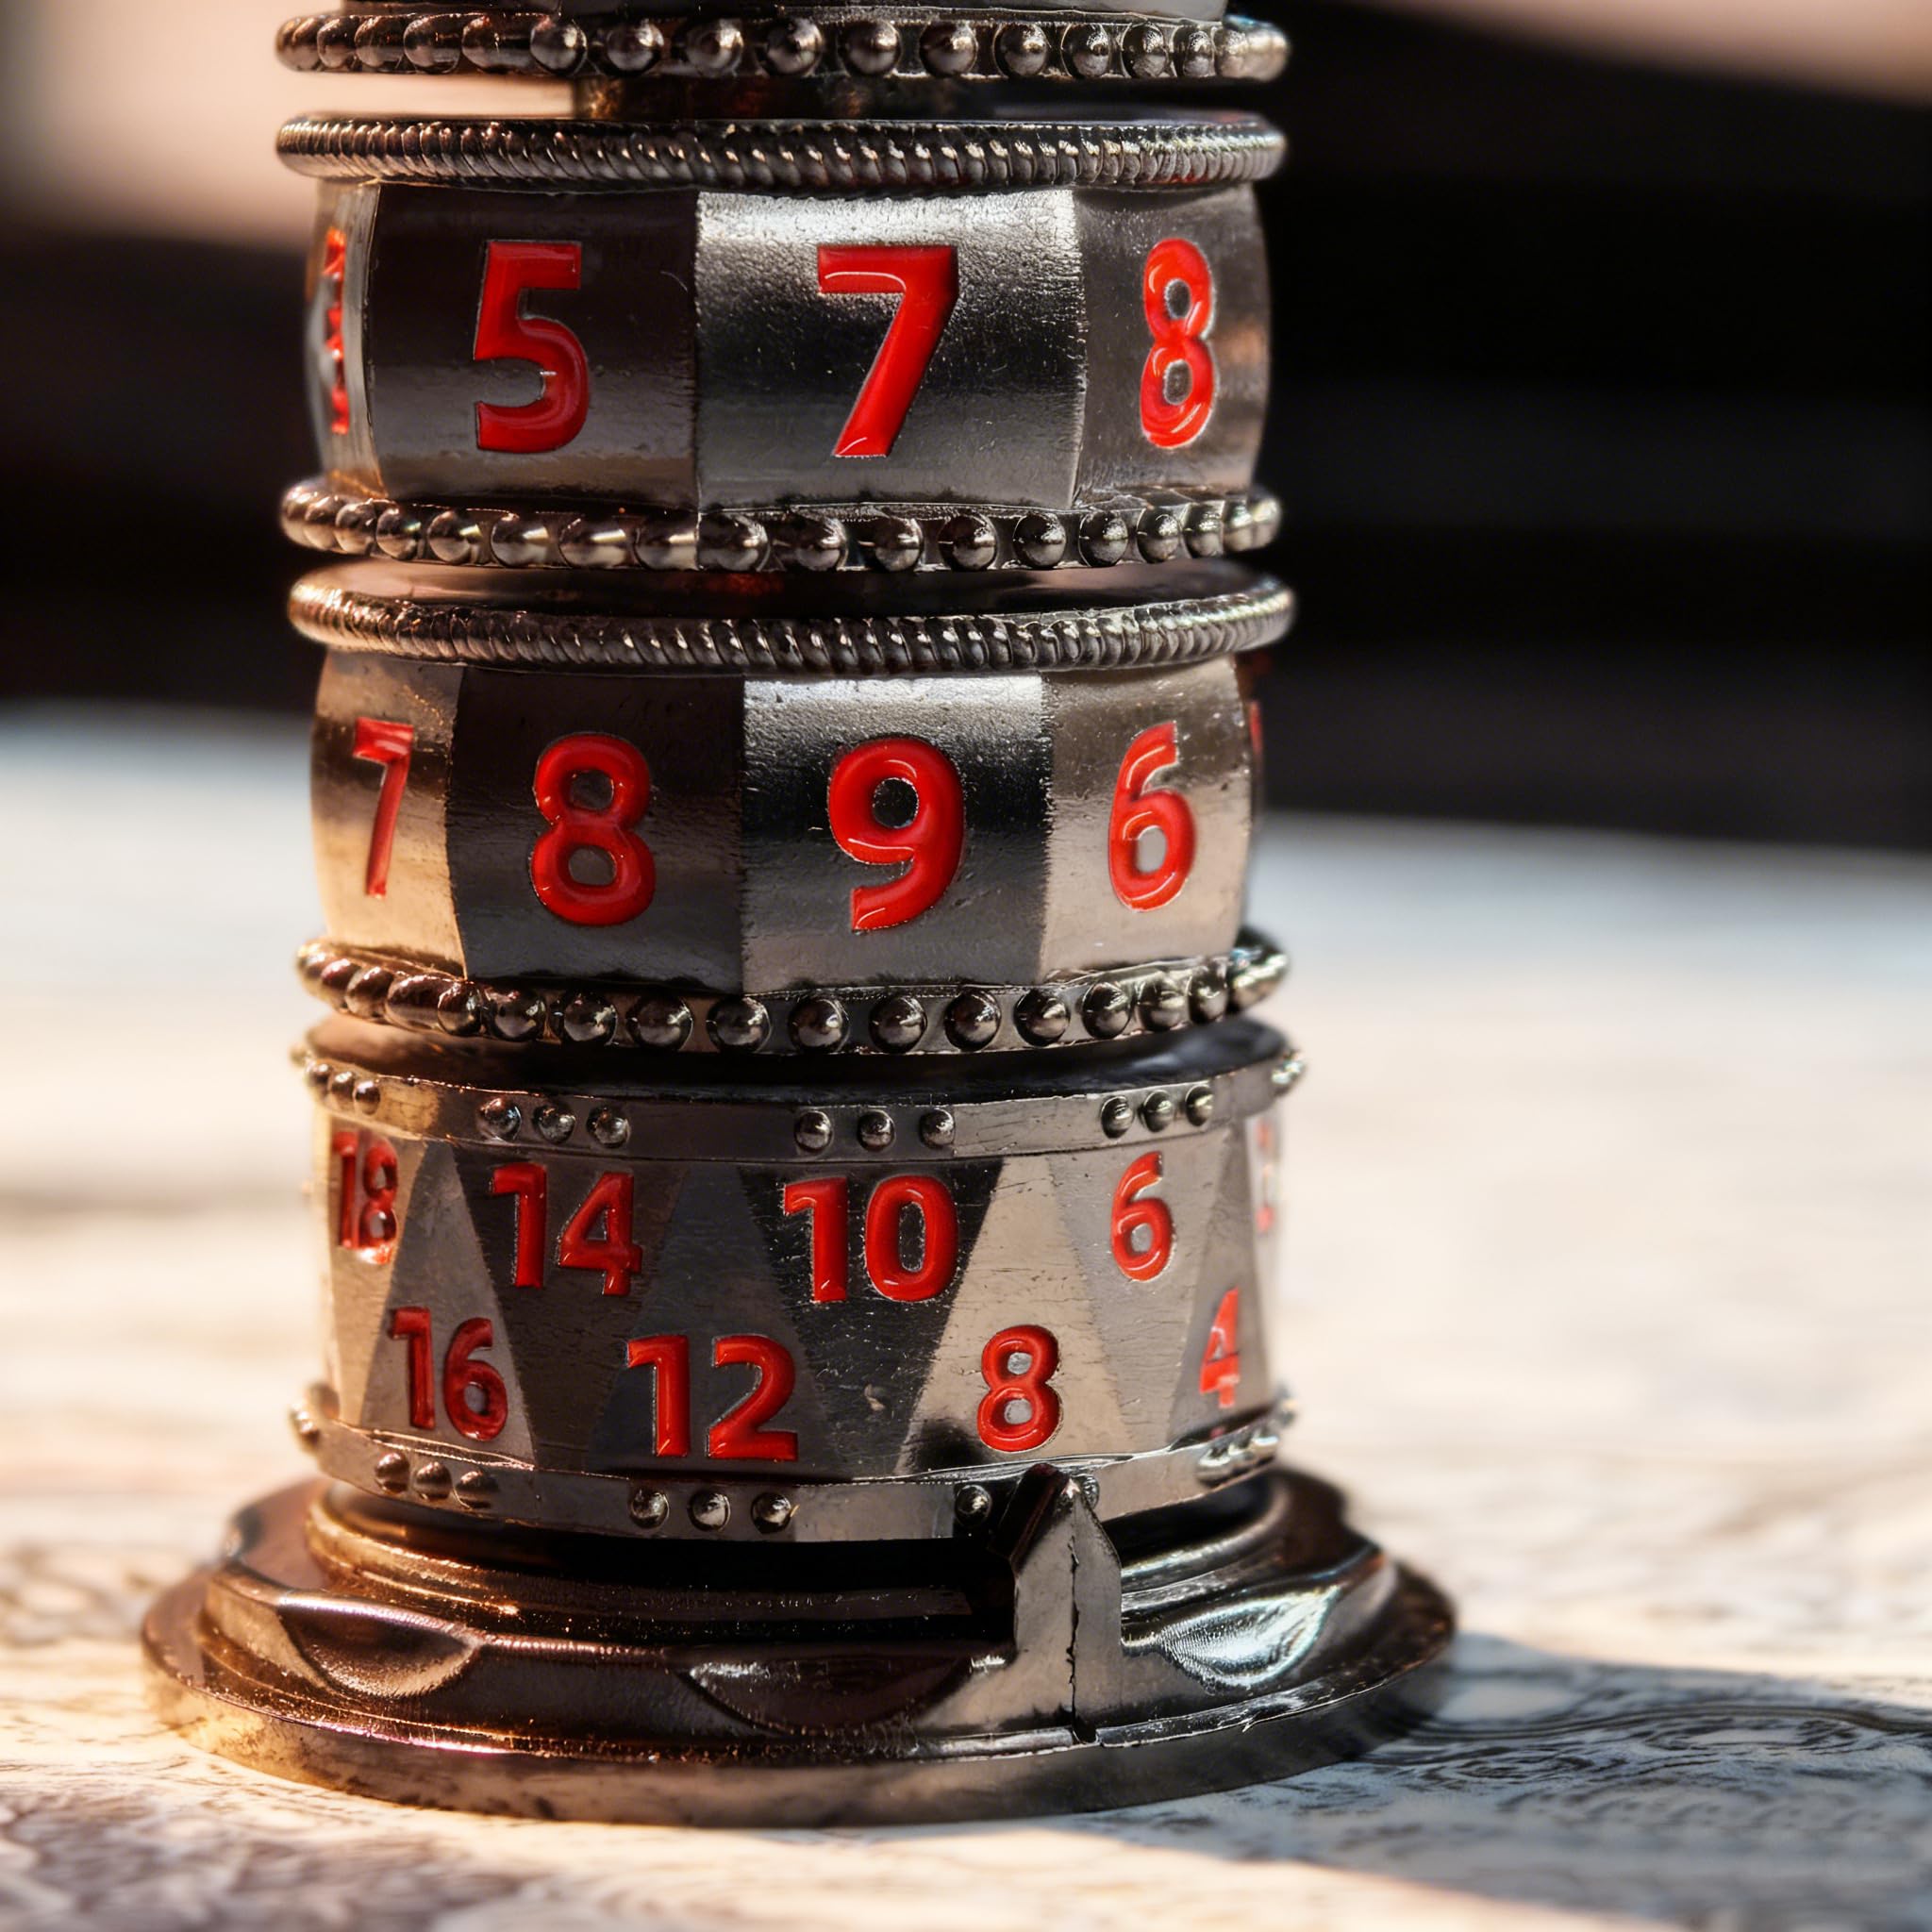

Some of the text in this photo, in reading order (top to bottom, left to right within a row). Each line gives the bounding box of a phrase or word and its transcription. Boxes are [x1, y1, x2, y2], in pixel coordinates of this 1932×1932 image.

[474, 240, 589, 454] 5
[817, 244, 958, 459] 7
[1140, 238, 1218, 450] 8
[352, 717, 1197, 933] 7 8 9 6
[332, 1130, 398, 1266] 18
[490, 1162, 642, 1296] 14
[784, 1175, 957, 1305] 10
[1111, 1151, 1177, 1281] 6
[389, 1286, 1241, 1461] 16 12 8 4
